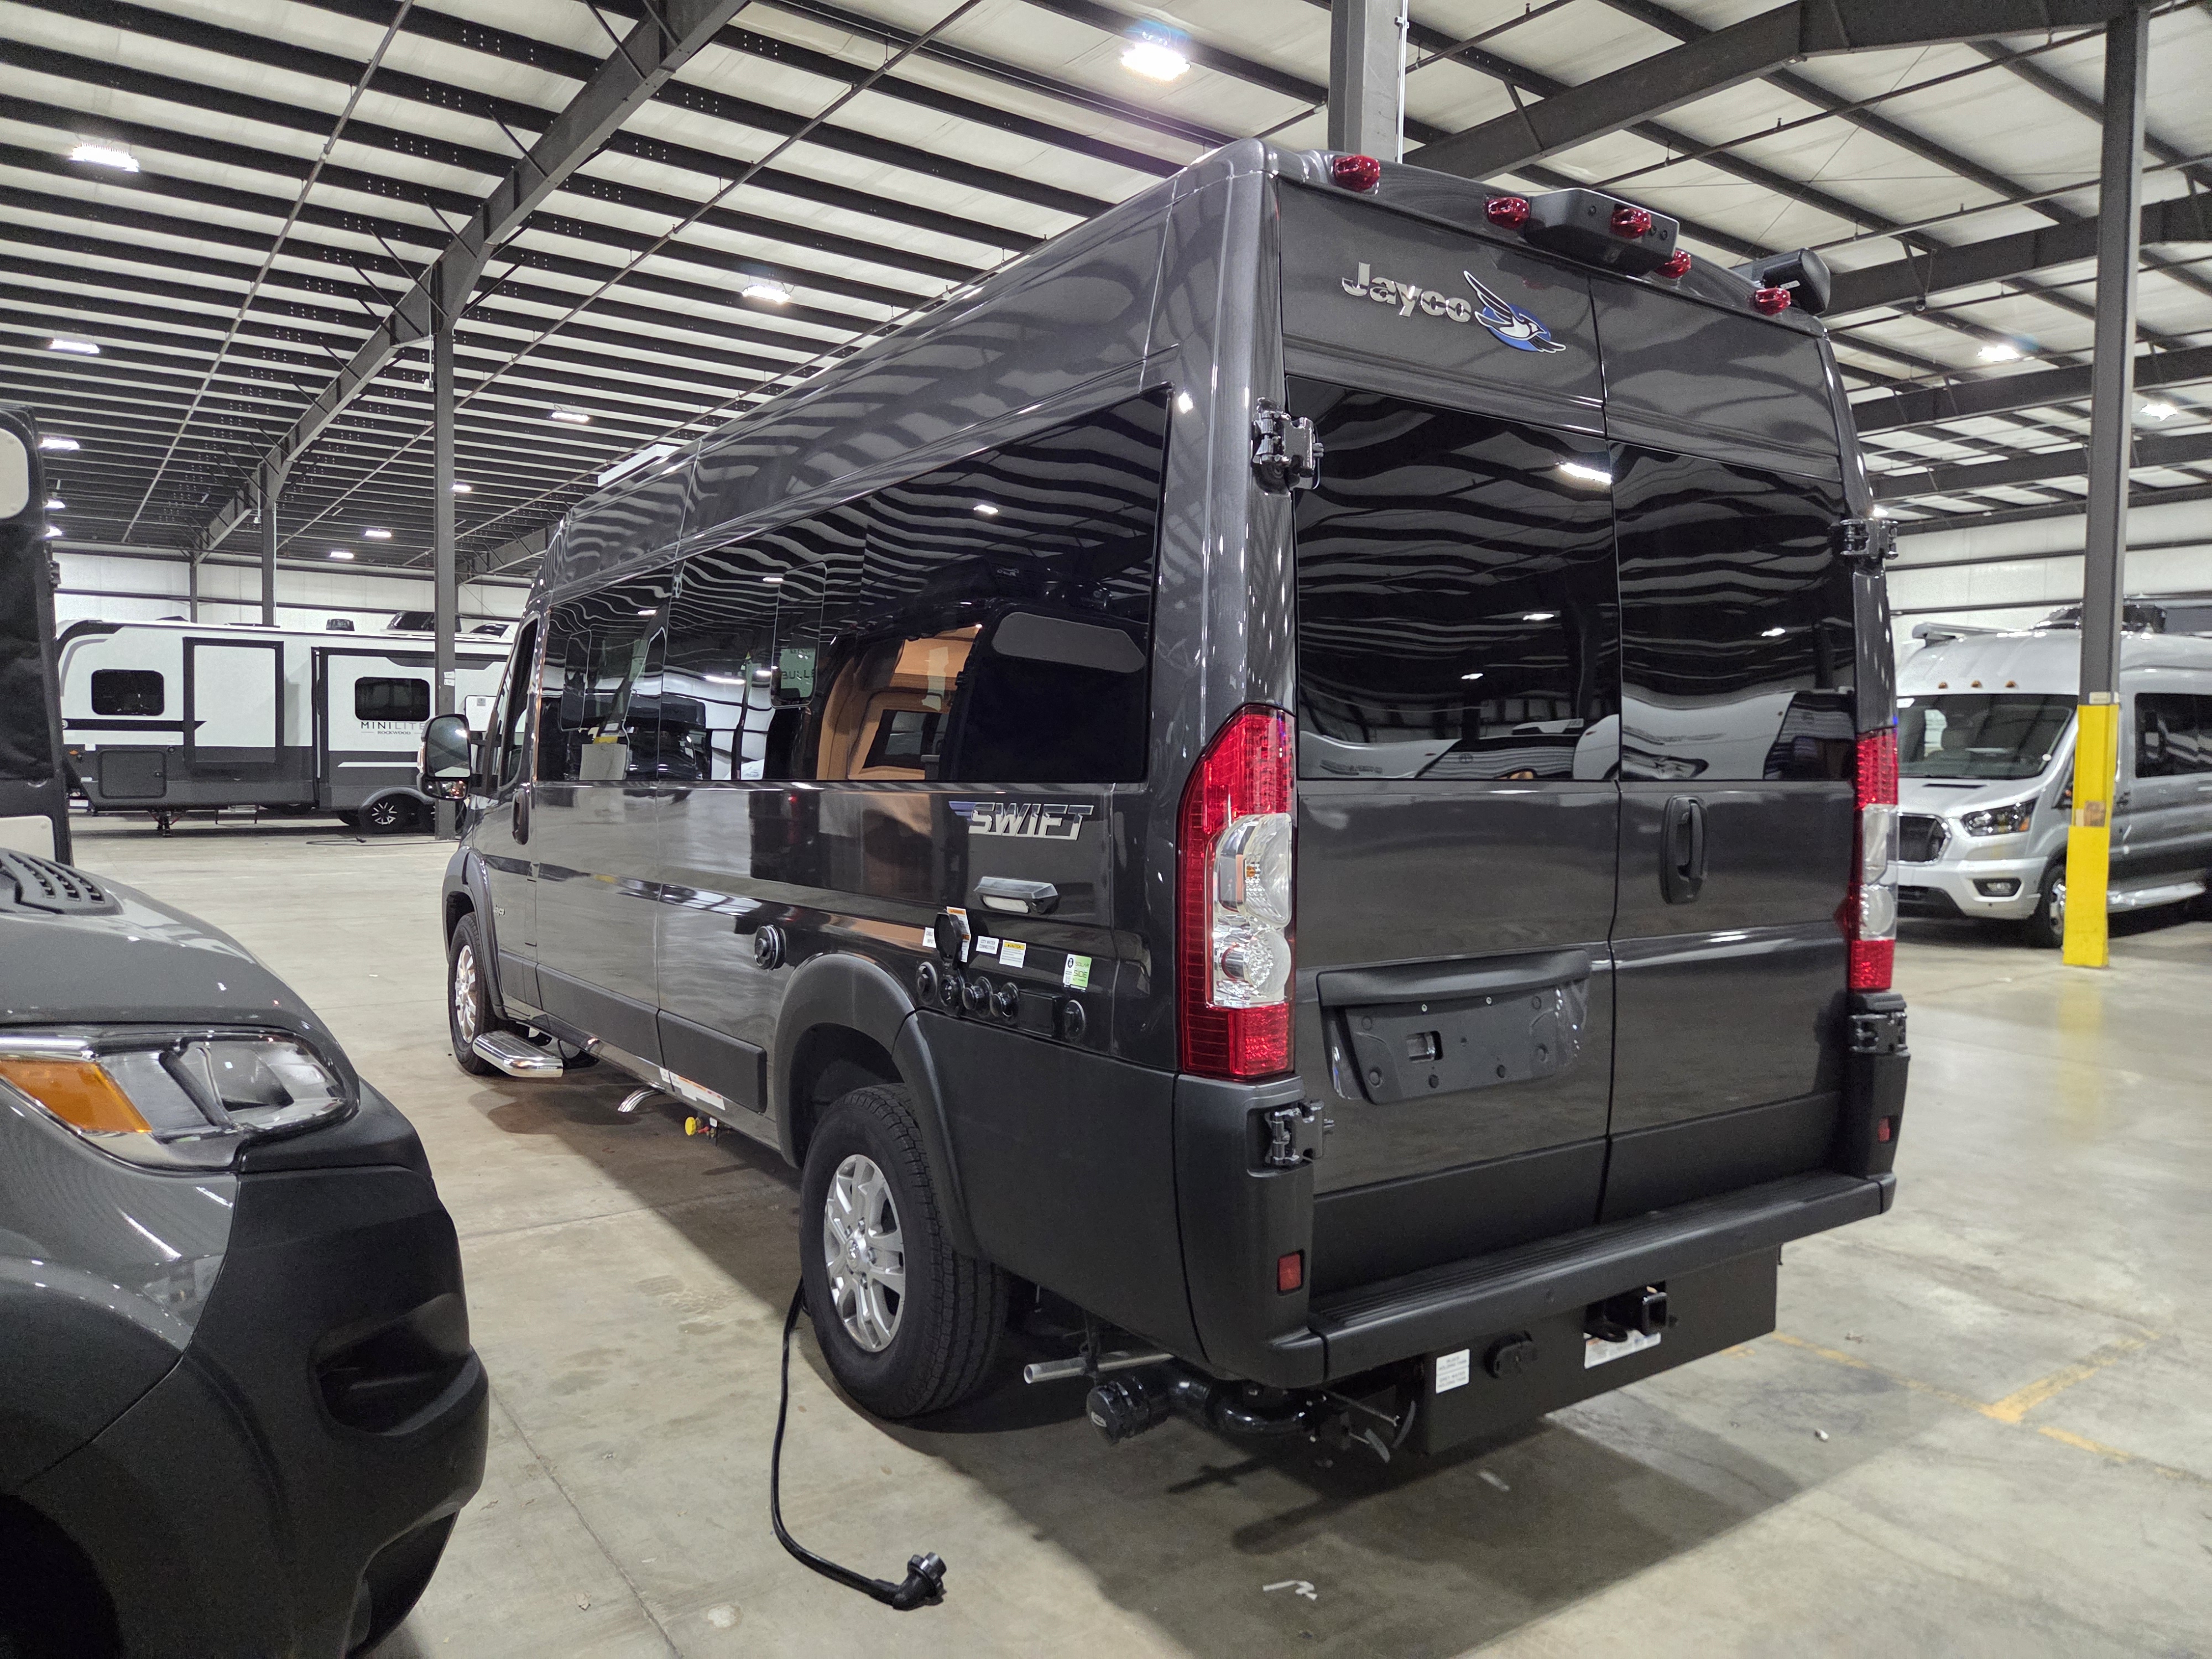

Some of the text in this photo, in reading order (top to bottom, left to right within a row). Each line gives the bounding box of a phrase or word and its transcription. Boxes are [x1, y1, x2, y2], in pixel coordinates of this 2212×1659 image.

[1342, 262, 1472, 323] Jayco
[968, 802, 1094, 841] SWIFT
[1073, 969, 1088, 979] SIDE
